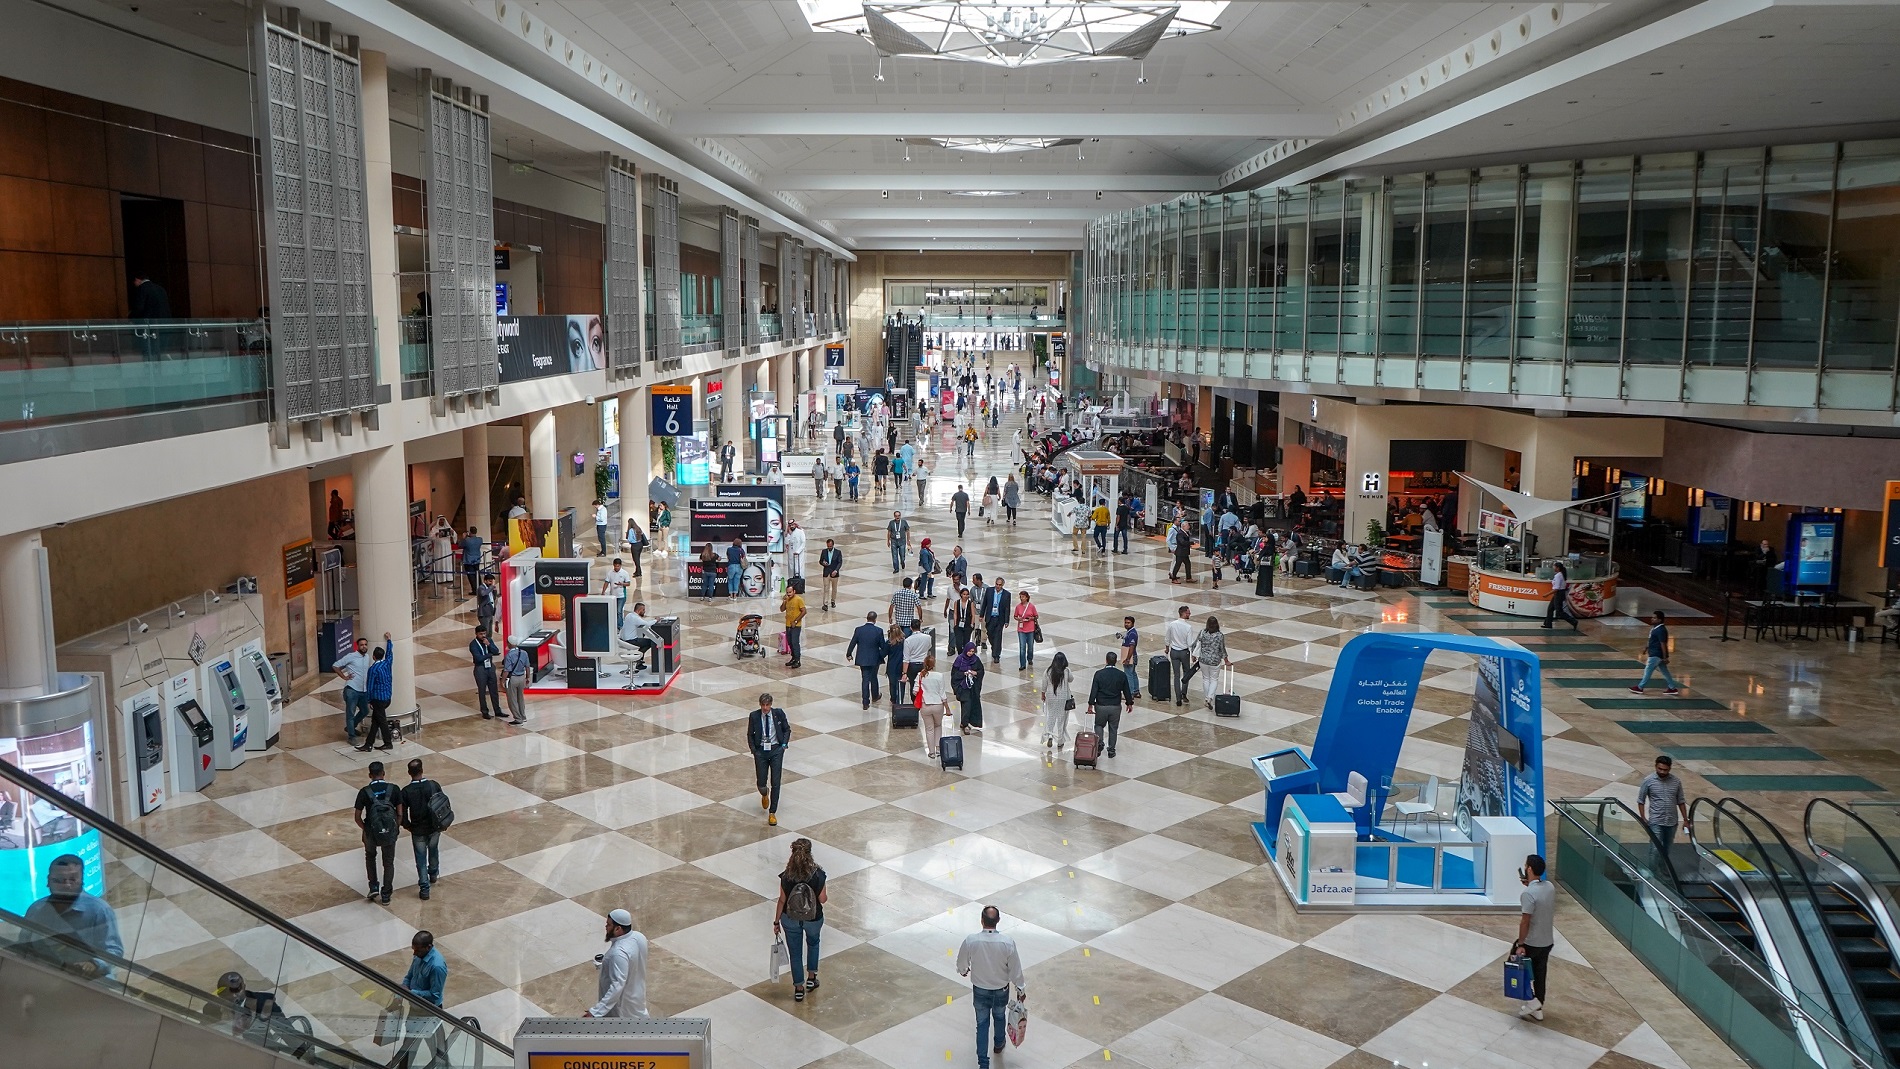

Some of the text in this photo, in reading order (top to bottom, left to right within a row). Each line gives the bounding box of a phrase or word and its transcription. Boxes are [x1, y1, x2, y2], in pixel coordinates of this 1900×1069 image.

[532, 354, 553, 369] Fragrance
[832, 355, 839, 366] 7
[666, 410, 680, 434] 6
[1488, 583, 1538, 595] FRESH PIZZA
[1516, 697, 1530, 712] WORLD
[1311, 884, 1353, 892] Jafza.ae
